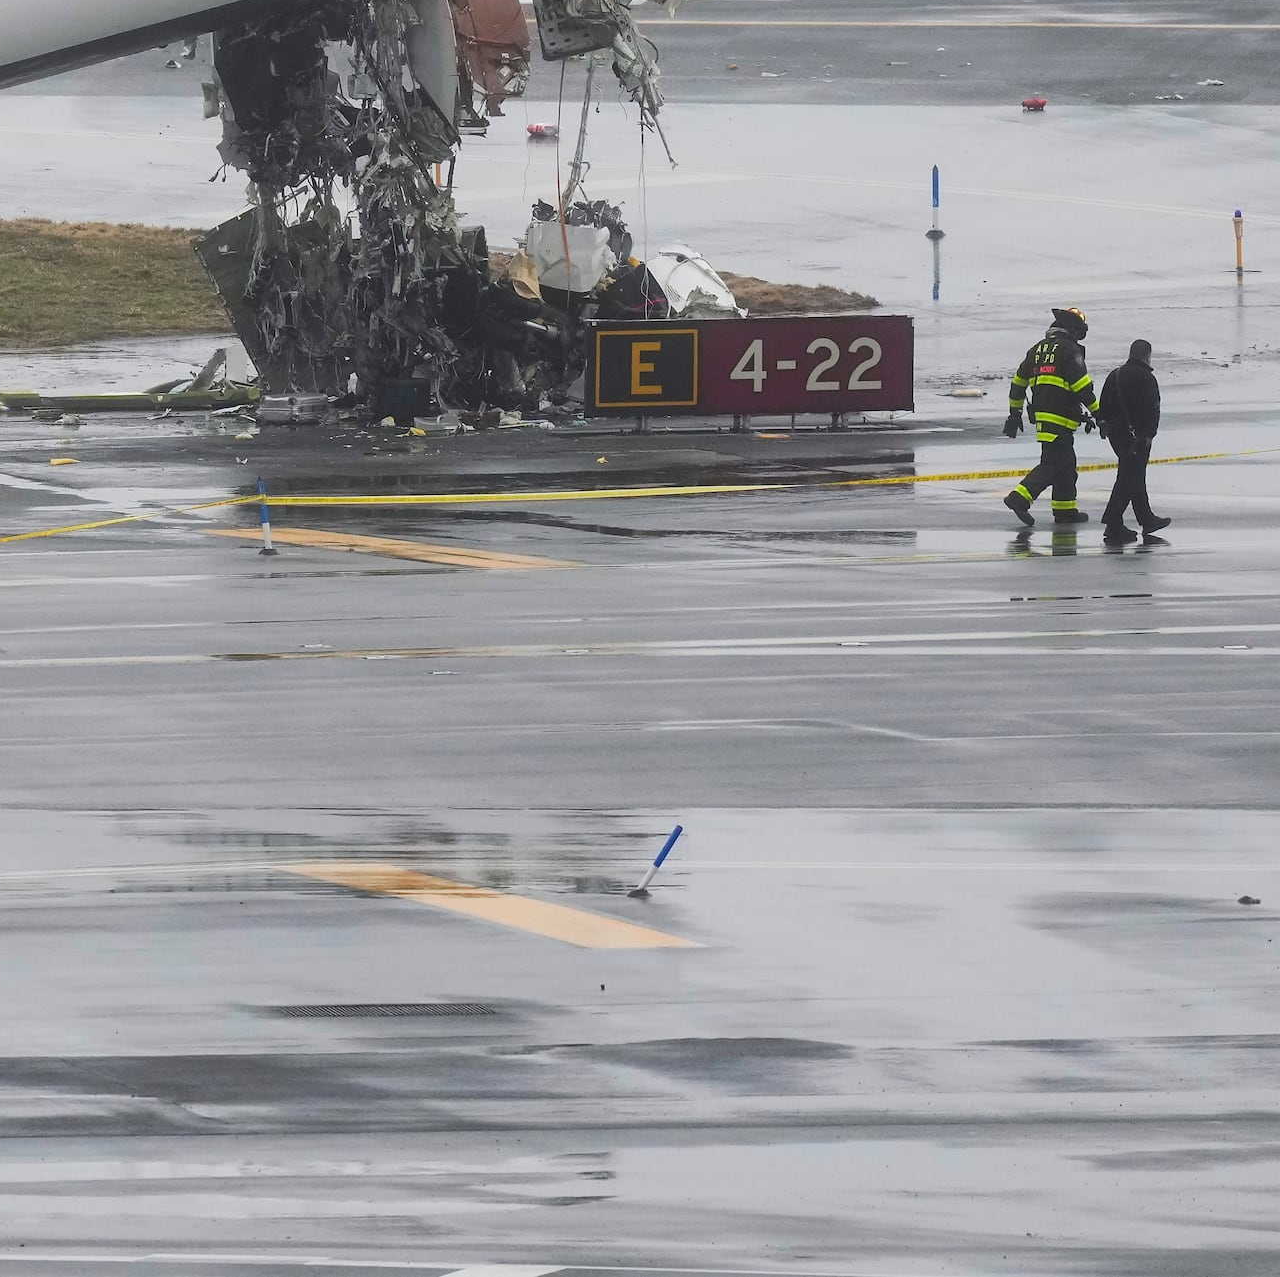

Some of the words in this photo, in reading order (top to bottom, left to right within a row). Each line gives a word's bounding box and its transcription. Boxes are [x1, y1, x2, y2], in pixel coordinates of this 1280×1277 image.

[1035, 343, 1059, 353] ARF
[1034, 354, 1055, 364] PPD
[630, 341, 663, 395] E
[729, 337, 883, 393] 4-22
